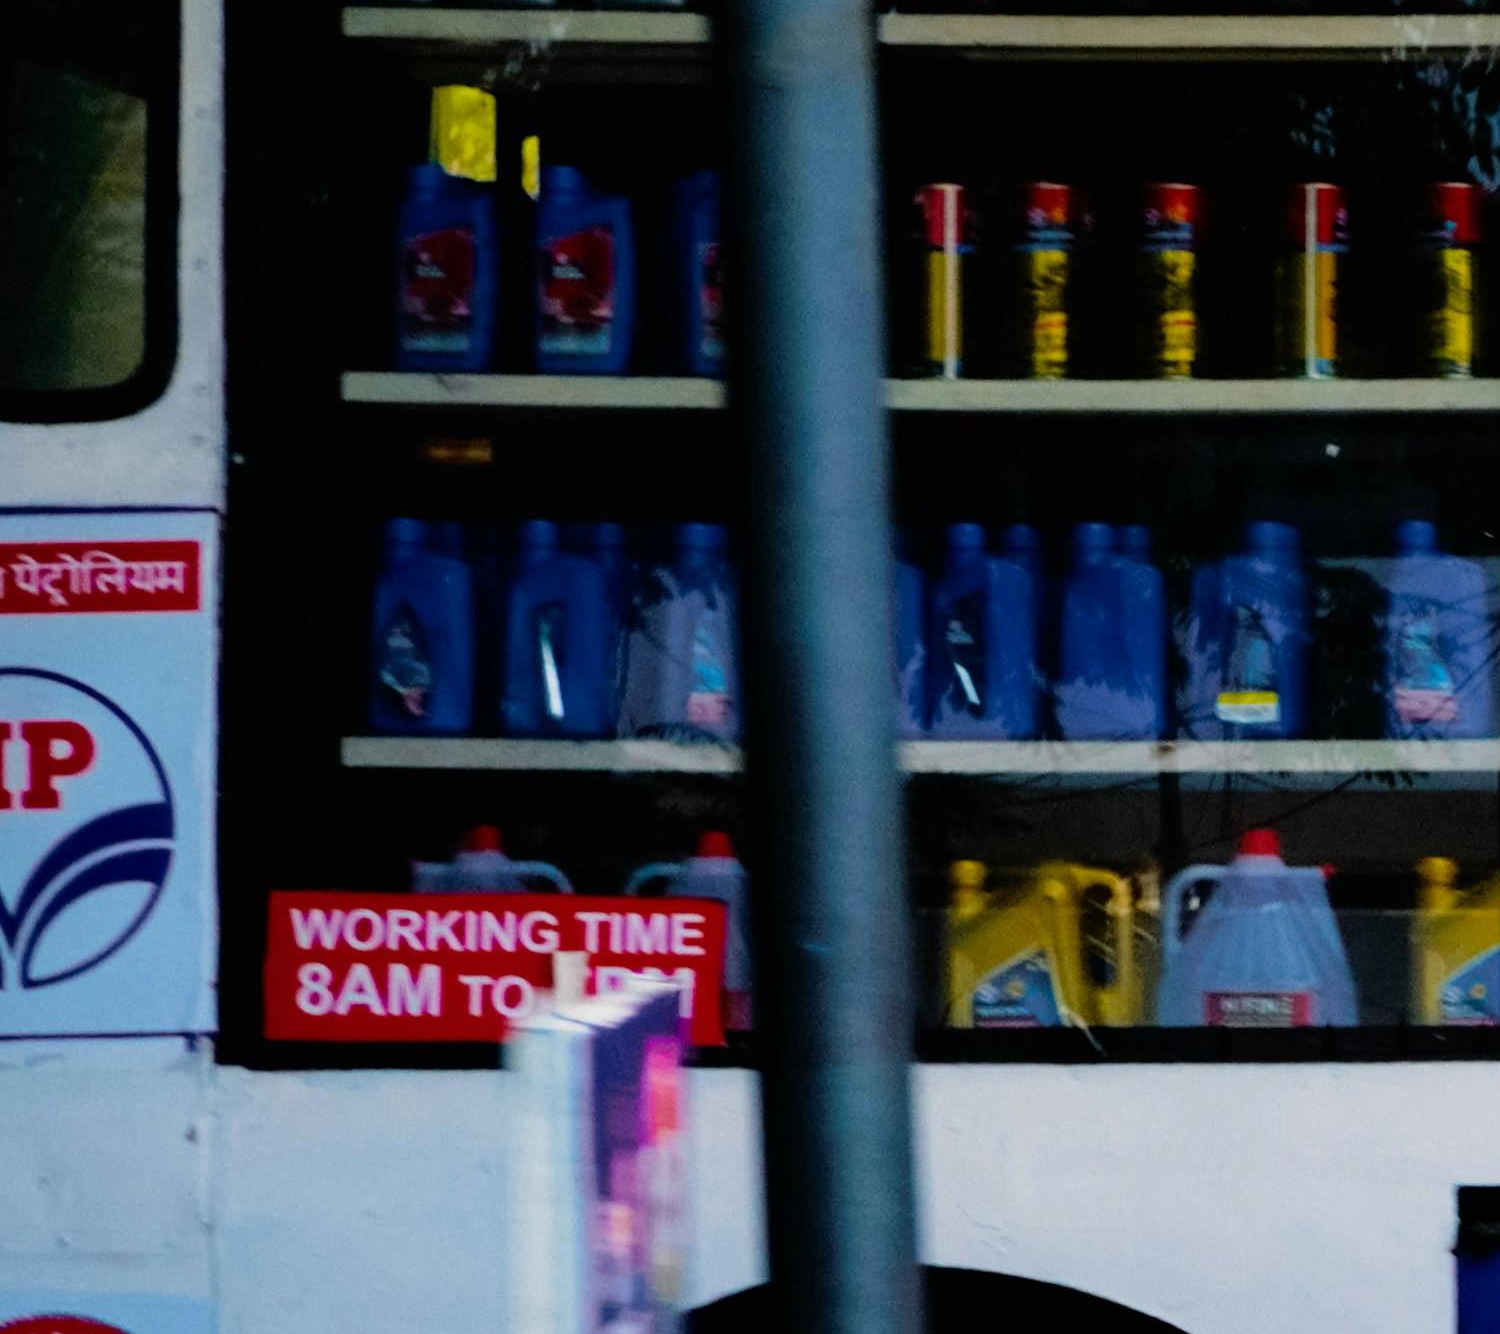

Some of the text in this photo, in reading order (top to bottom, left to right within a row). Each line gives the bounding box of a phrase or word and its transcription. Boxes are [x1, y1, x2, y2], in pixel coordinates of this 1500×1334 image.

[9, 549, 189, 607] पेट्रोलियम
[0, 721, 94, 809] P
[289, 907, 706, 956] WORKING TIME
[295, 962, 442, 1017] 8AM
[458, 974, 535, 1019] TO
